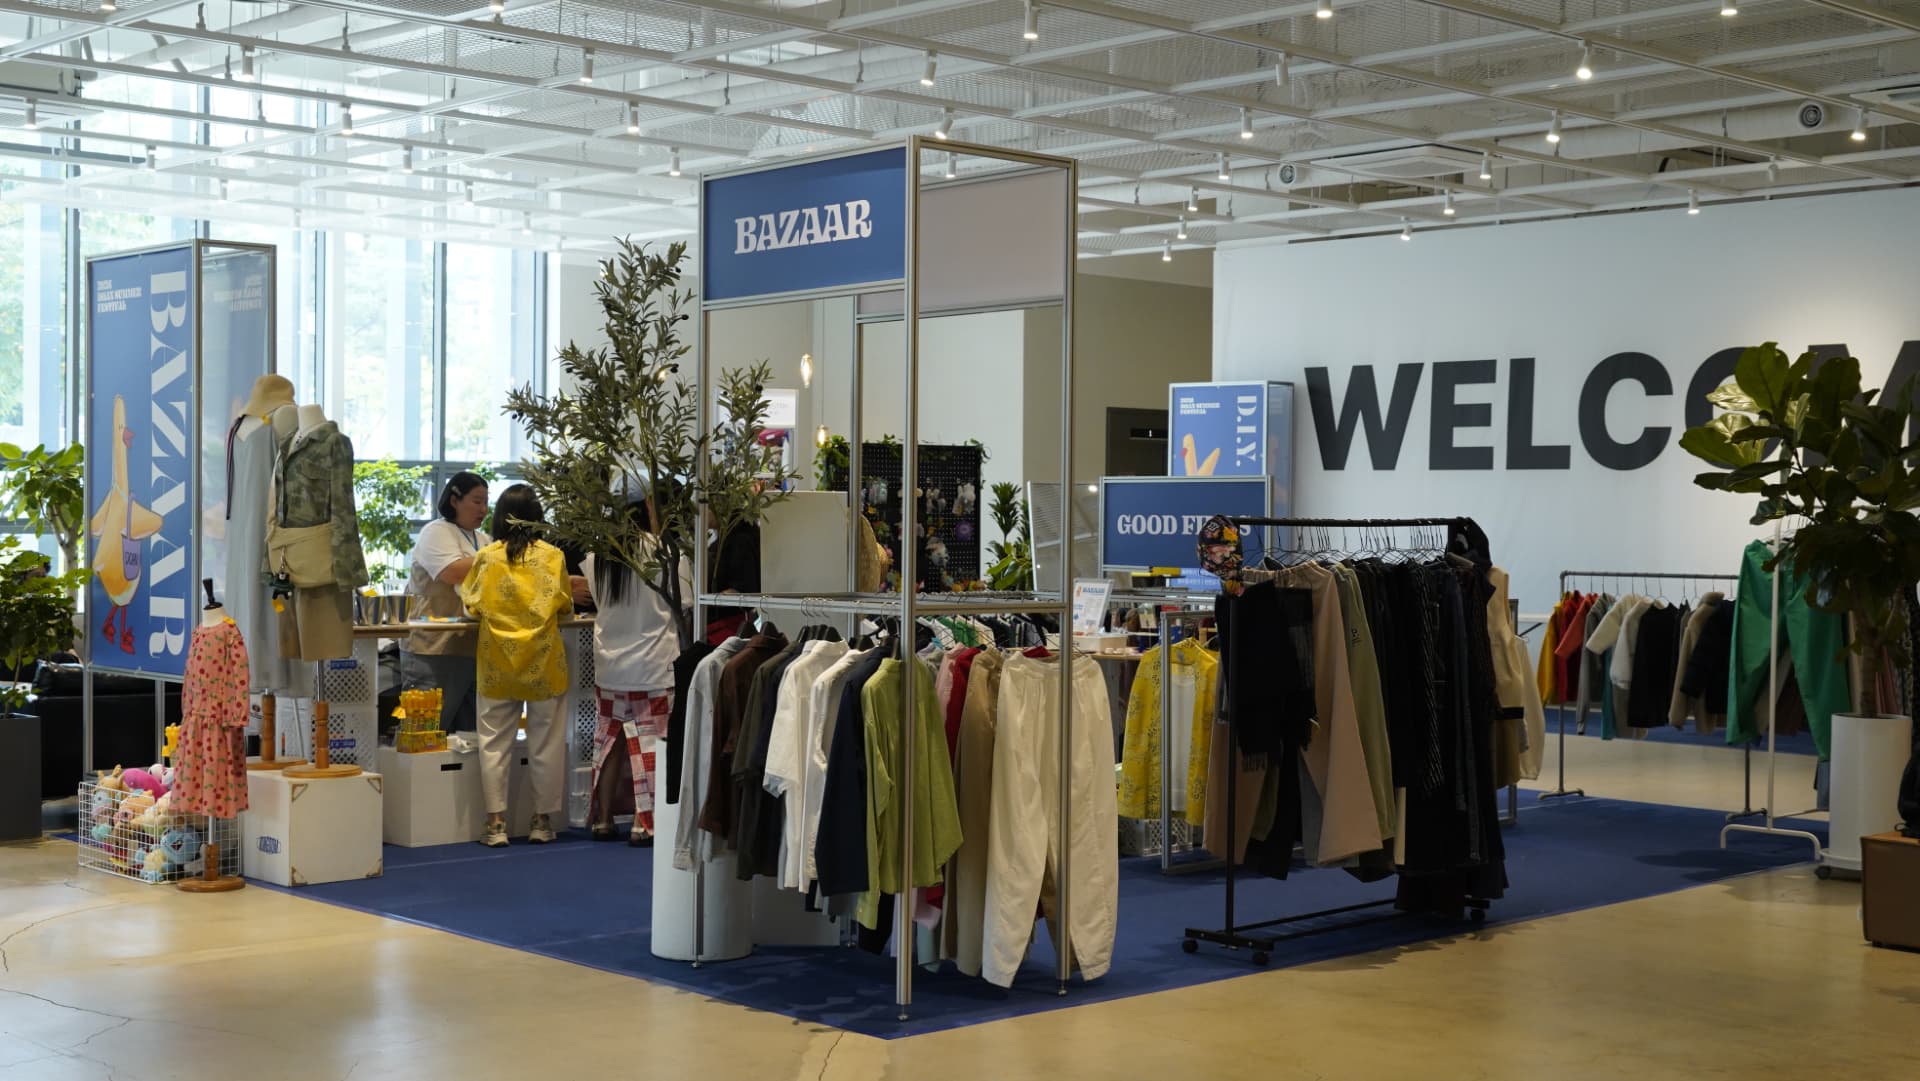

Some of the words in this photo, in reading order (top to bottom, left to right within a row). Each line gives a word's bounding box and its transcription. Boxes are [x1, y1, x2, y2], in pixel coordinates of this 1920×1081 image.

[734, 199, 873, 255] BAZAAR
[1236, 395, 1257, 467] D.I.Y.
[149, 270, 187, 659] BAZAAR
[1117, 513, 1178, 535] GOOD
[1181, 513, 1252, 537] FIS
